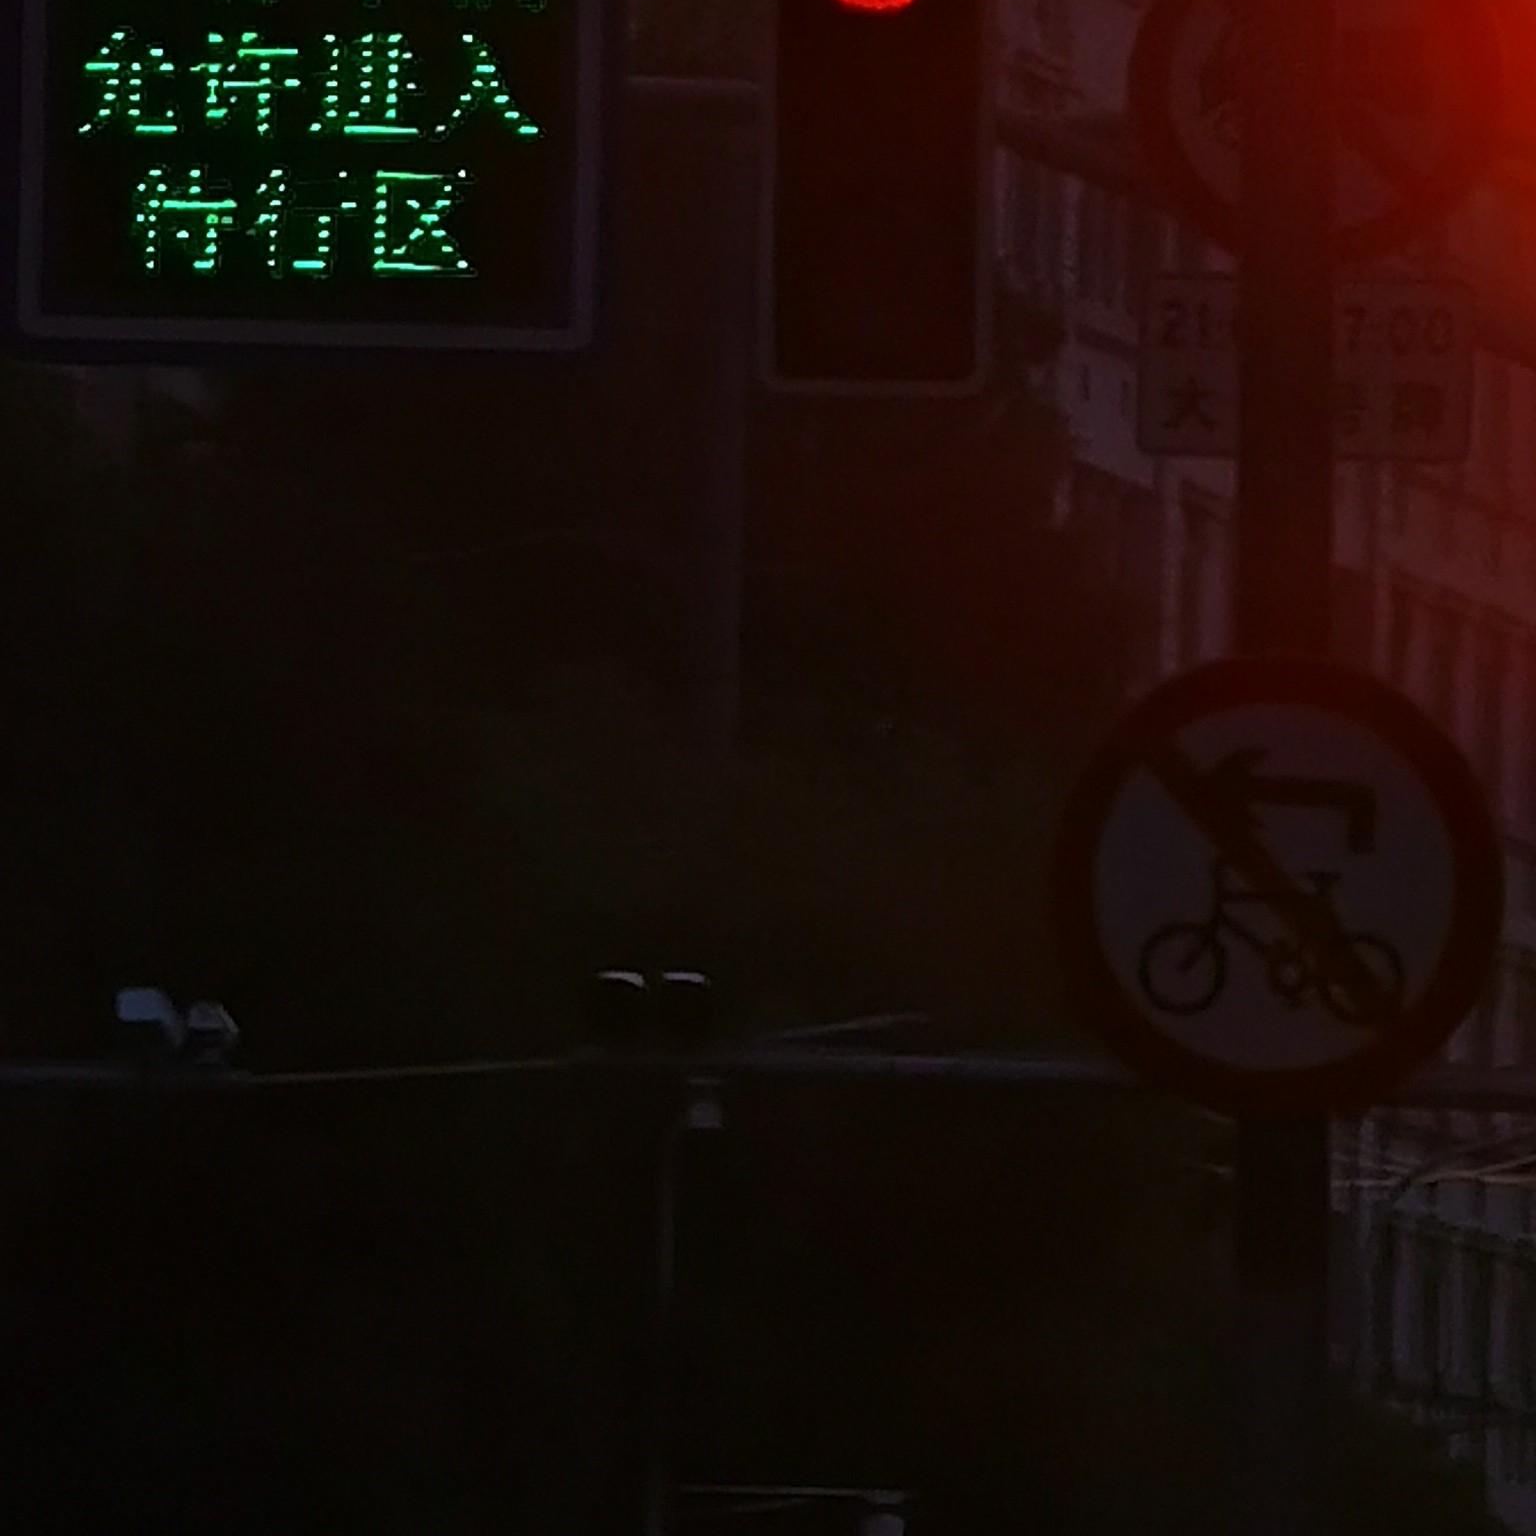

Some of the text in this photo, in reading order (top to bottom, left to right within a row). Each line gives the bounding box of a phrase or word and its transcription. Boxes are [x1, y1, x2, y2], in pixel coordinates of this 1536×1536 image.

[79, 26, 546, 140] 允许进入
[136, 165, 476, 277] 待行区
